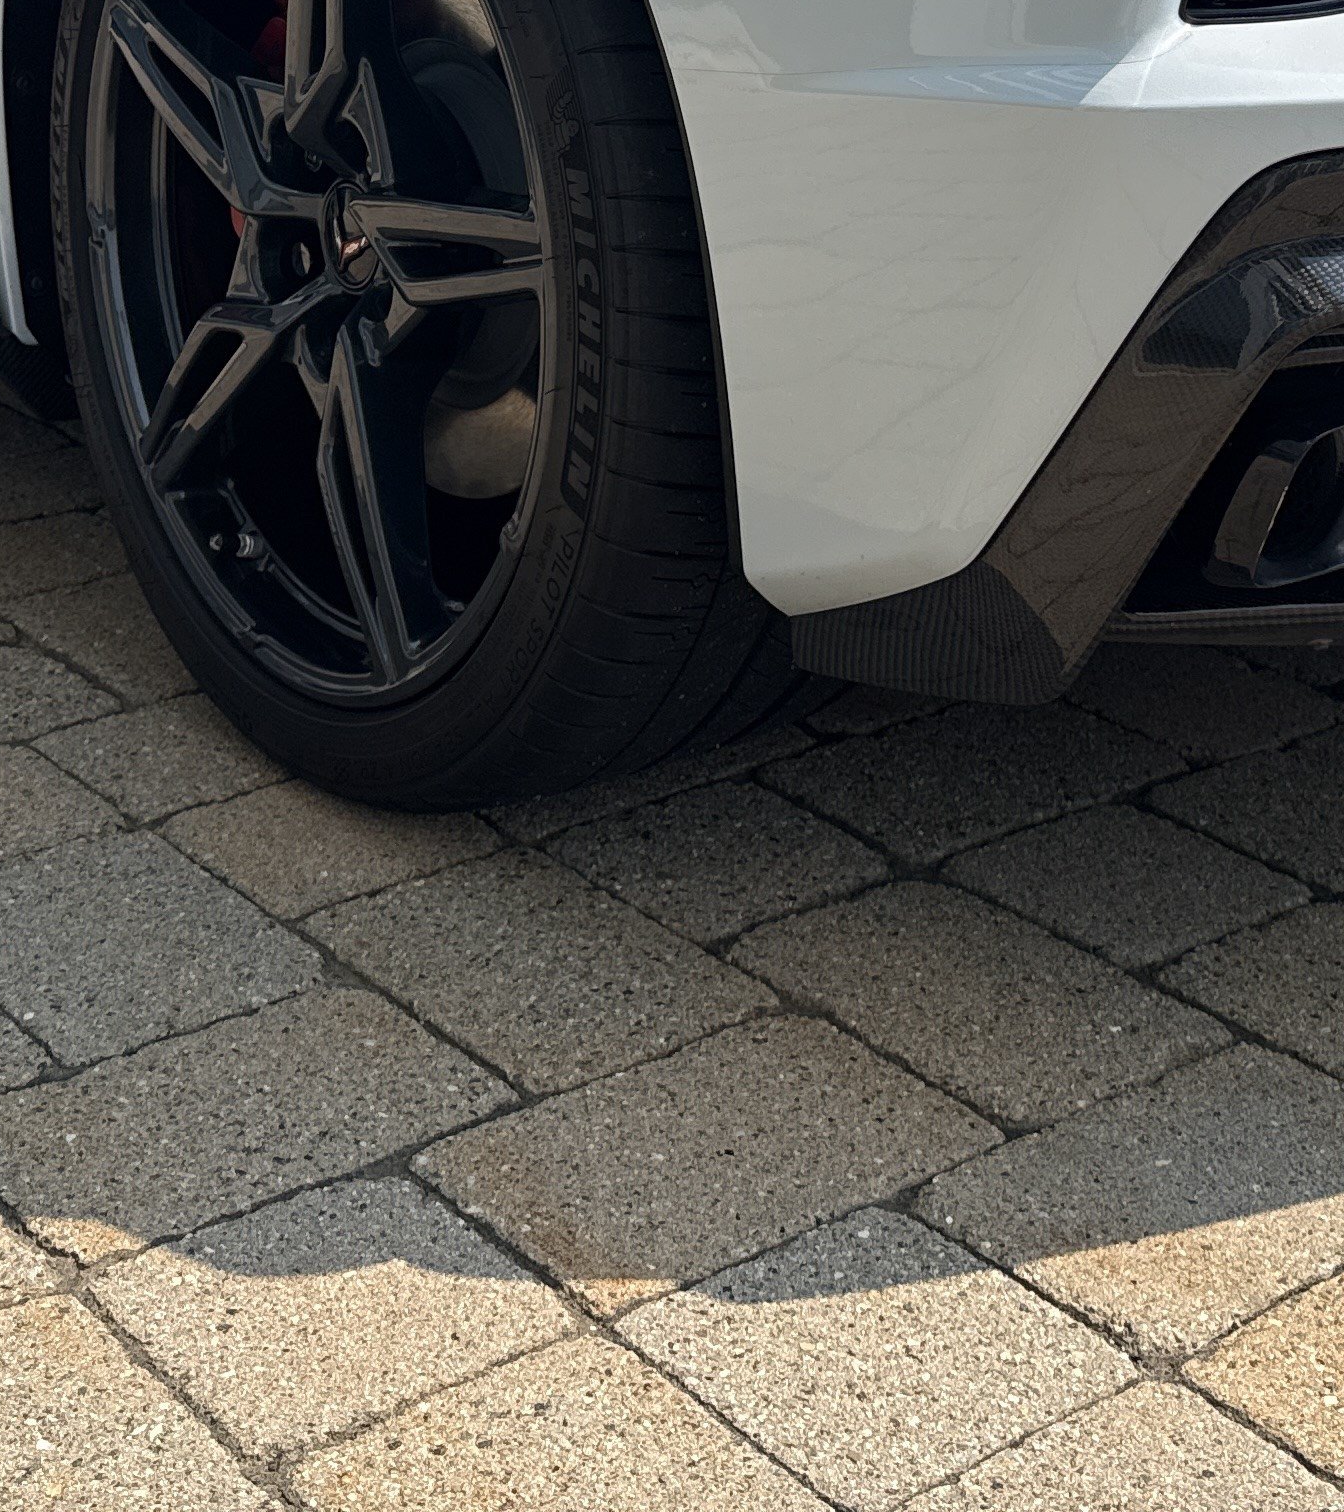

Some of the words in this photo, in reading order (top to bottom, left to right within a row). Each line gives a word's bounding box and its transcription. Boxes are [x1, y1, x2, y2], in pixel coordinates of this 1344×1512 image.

[564, 167, 602, 502] MICHELIN
[541, 534, 575, 621] PILOT
[498, 616, 544, 698] SPORT
